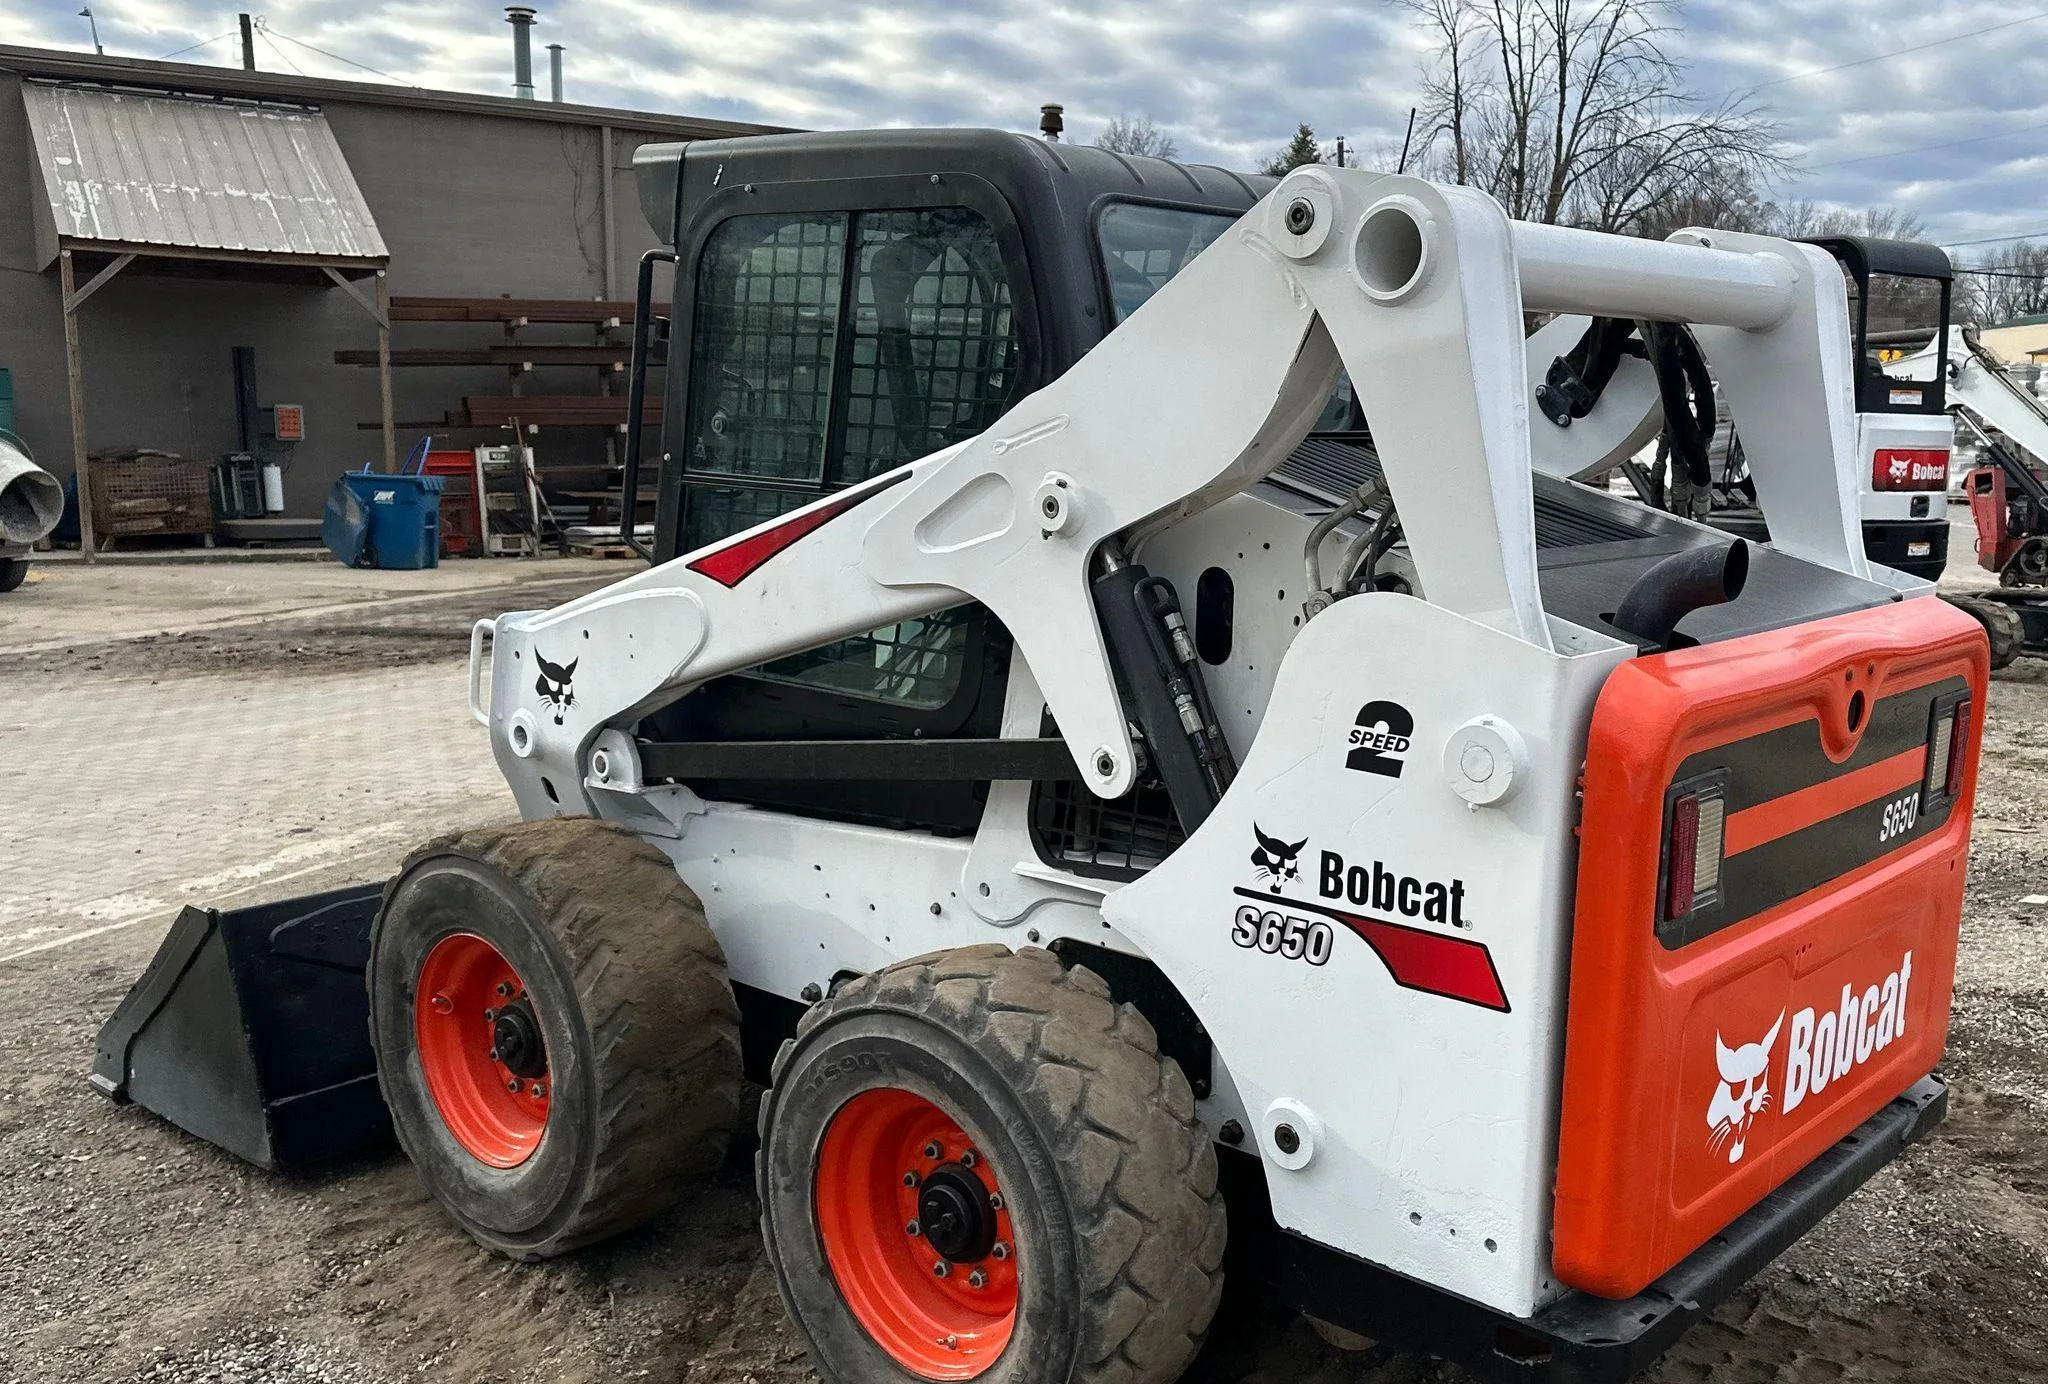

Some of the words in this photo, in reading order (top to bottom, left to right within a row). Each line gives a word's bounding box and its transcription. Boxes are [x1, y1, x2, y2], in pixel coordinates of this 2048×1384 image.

[1911, 462, 1944, 480] Bobcat
[1345, 700, 1414, 778] 2
[1348, 729, 1410, 753] SPEED
[1879, 792, 1919, 842] S650
[1319, 849, 1465, 928] Bobcat
[1232, 905, 1333, 966] S650
[1782, 950, 1913, 1115] Bobcat
